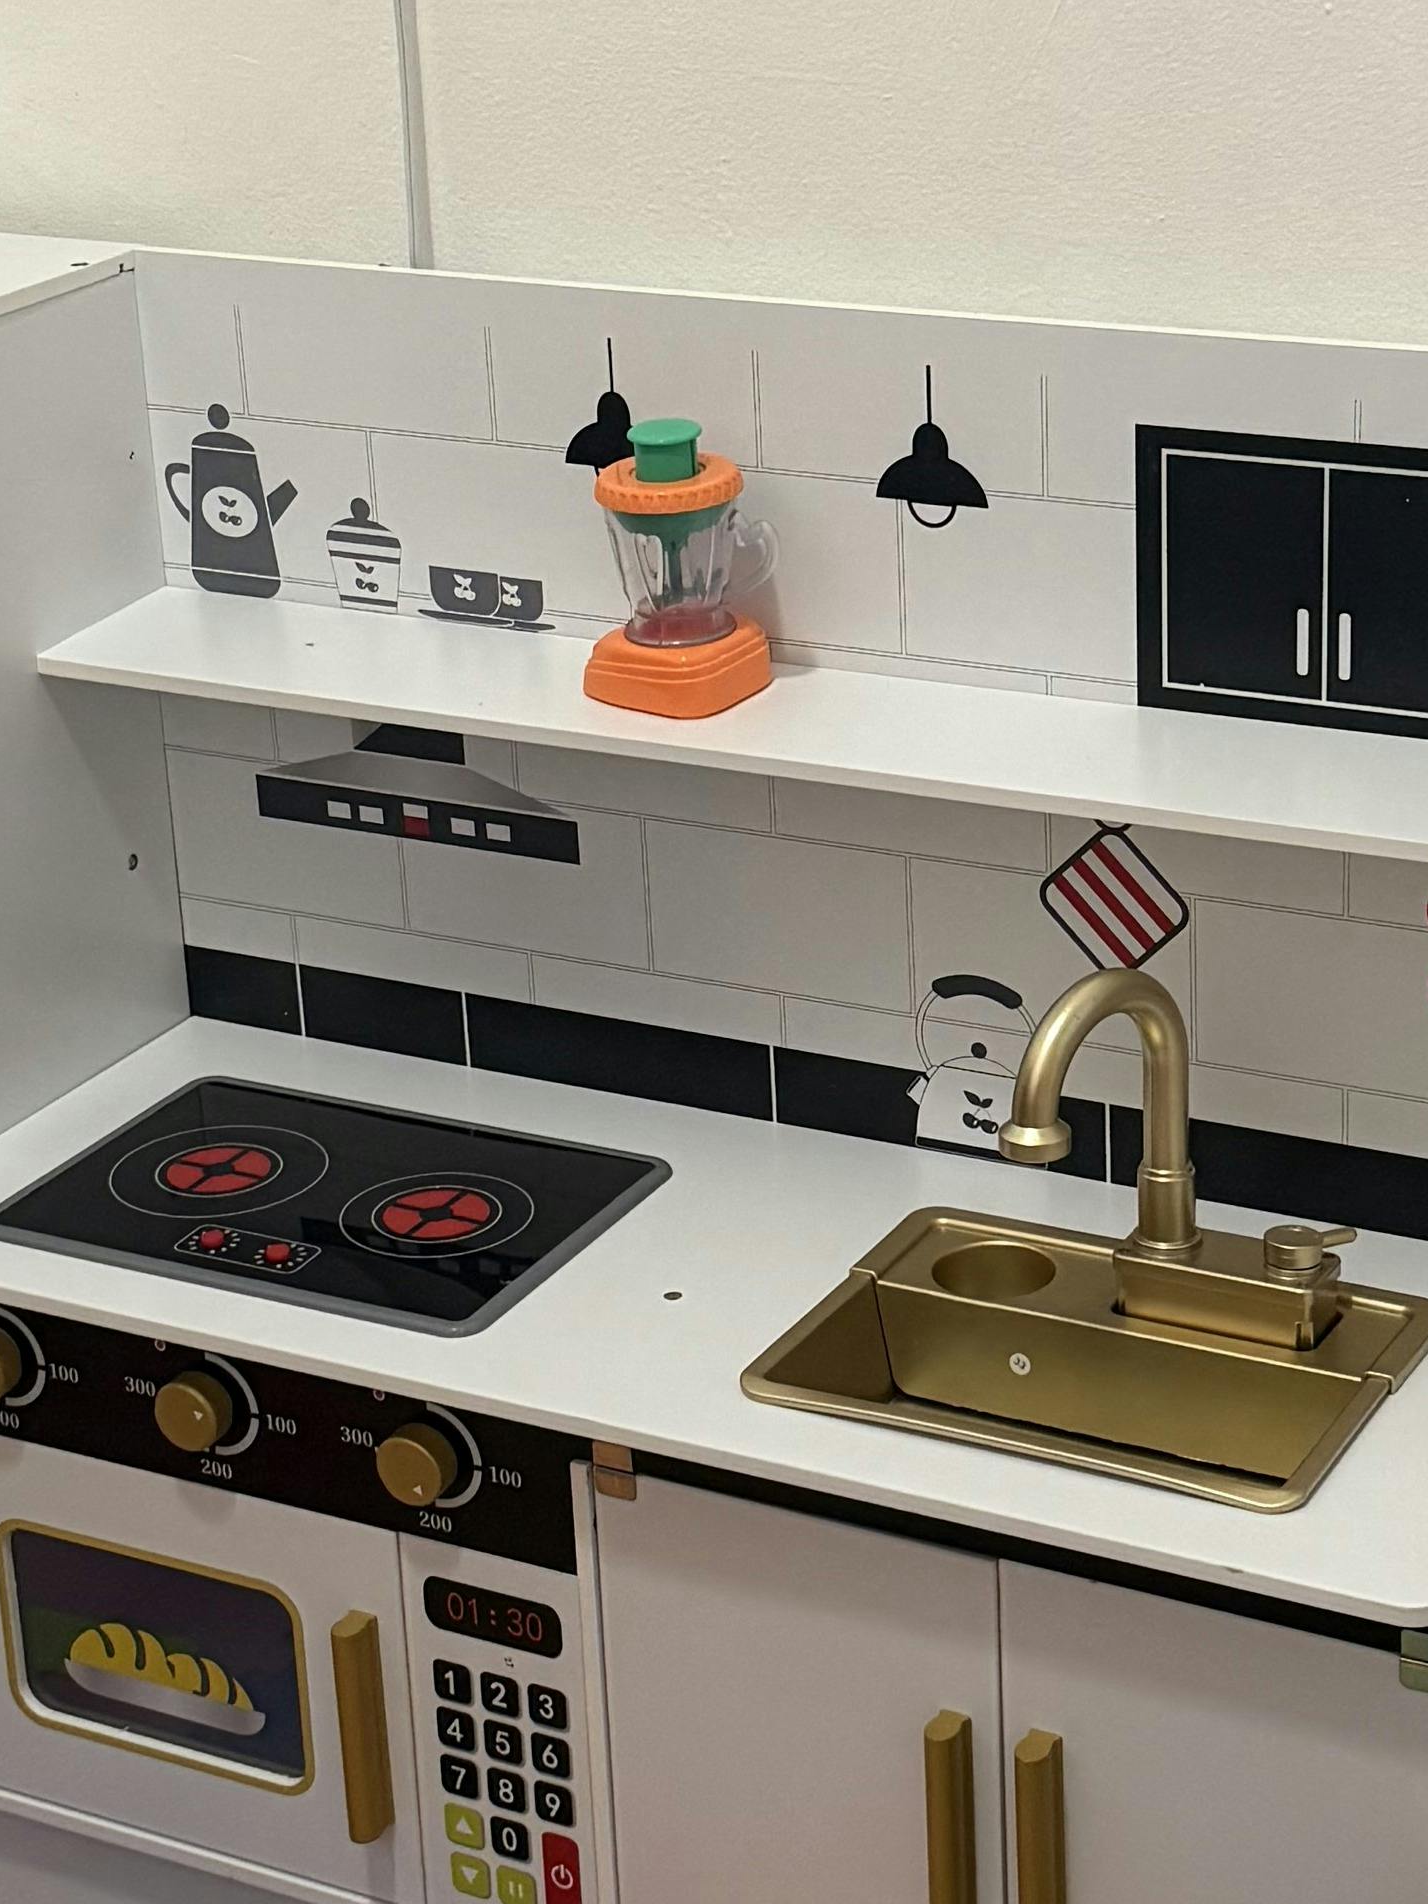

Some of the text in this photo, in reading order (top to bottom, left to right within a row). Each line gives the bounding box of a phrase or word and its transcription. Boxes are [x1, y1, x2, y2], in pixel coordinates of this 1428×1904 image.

[48, 1363, 79, 1384] 100
[124, 1376, 156, 1397] 300
[266, 1414, 297, 1436] 100
[340, 1426, 373, 1448] 300
[200, 1458, 232, 1480] 200
[489, 1466, 522, 1489] 100
[419, 1511, 452, 1534] 200
[443, 1669, 555, 1720] 1 2 3
[446, 1718, 558, 1769] 4 5 6
[450, 1764, 561, 1818] 7 8 9
[502, 1827, 517, 1852] 0
